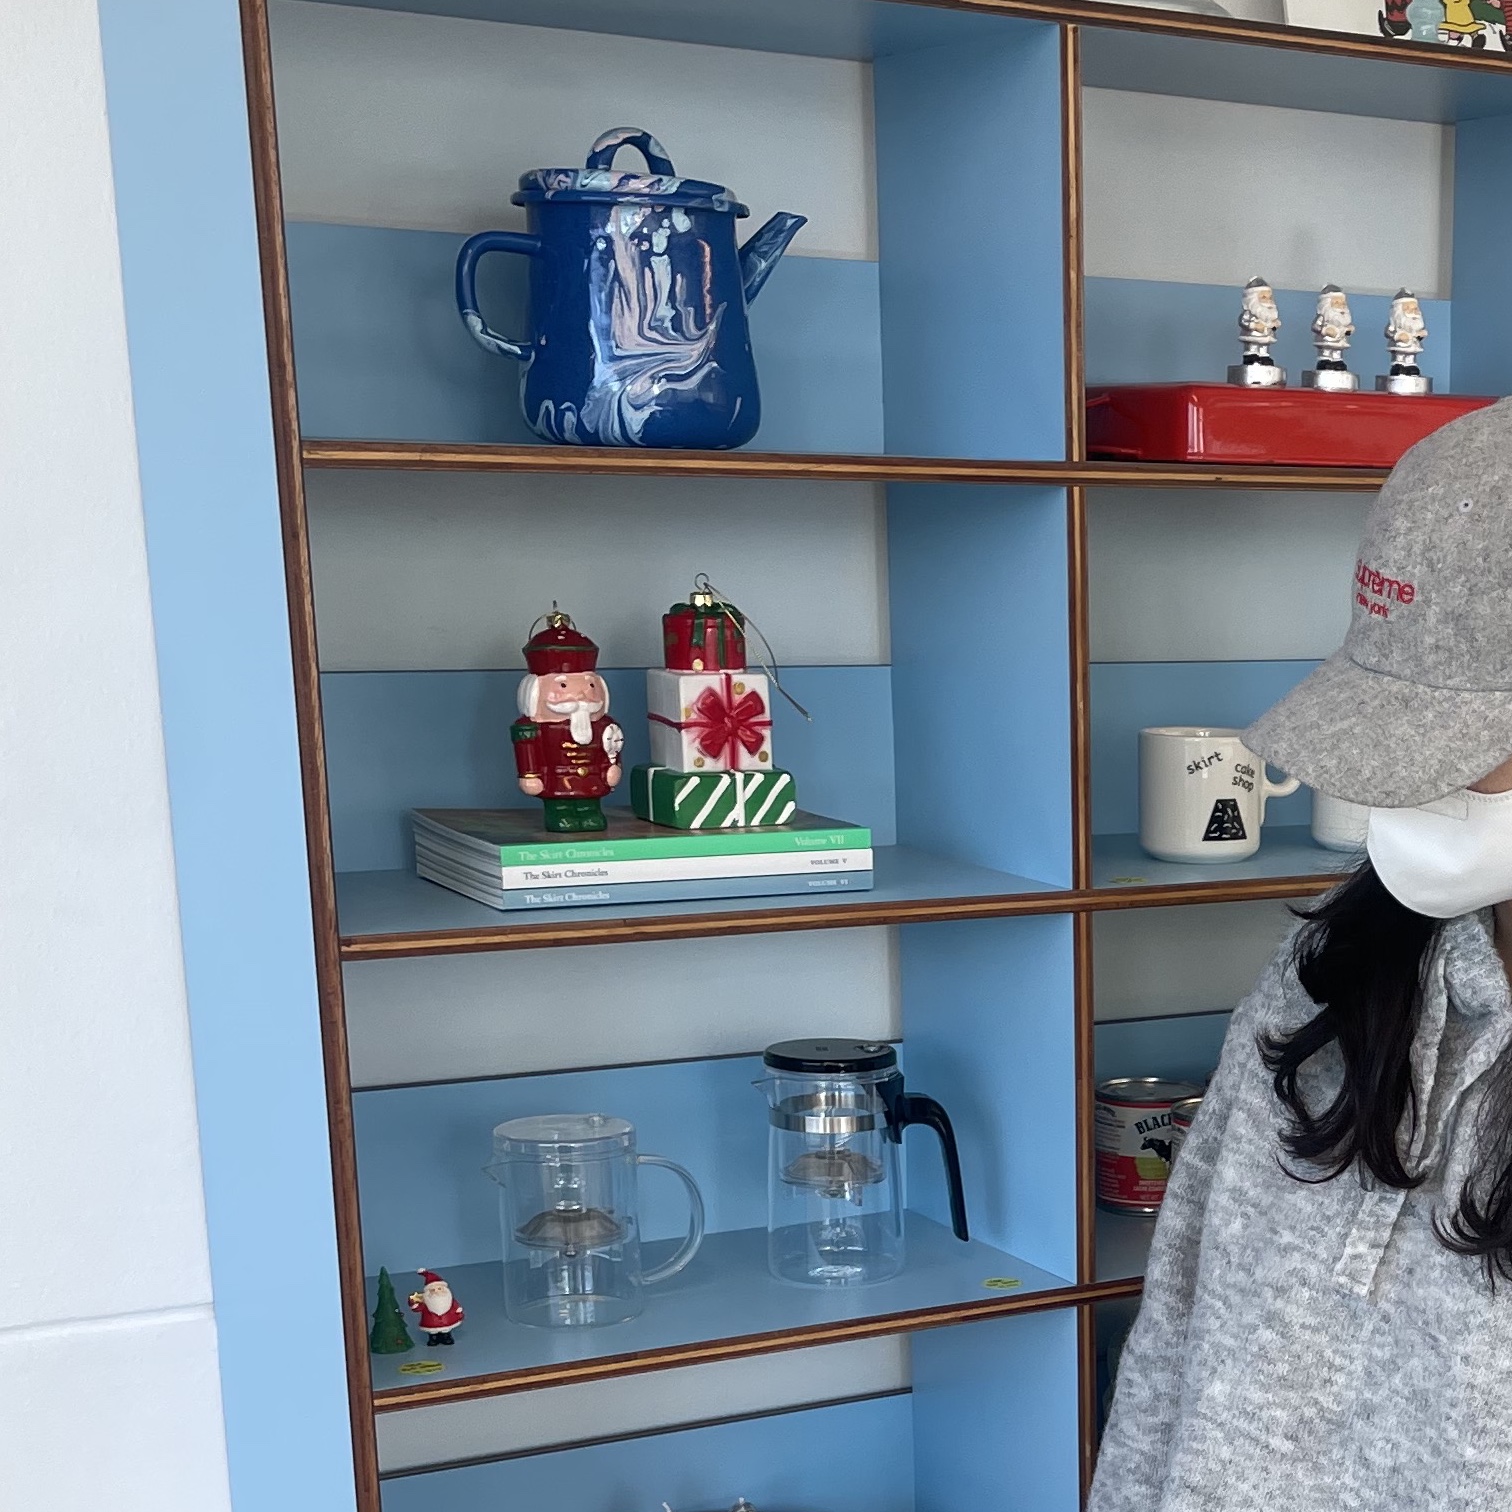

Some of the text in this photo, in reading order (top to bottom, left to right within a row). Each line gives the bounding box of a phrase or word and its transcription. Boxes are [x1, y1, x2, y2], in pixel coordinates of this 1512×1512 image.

[1356, 559, 1415, 604] upreme
[1186, 751, 1223, 774] skirt
[1234, 763, 1255, 778] cake
[1231, 775, 1254, 792] shop
[523, 868, 609, 881] The Skirt Chronicles
[524, 890, 610, 904] The Skirt Chronicles
